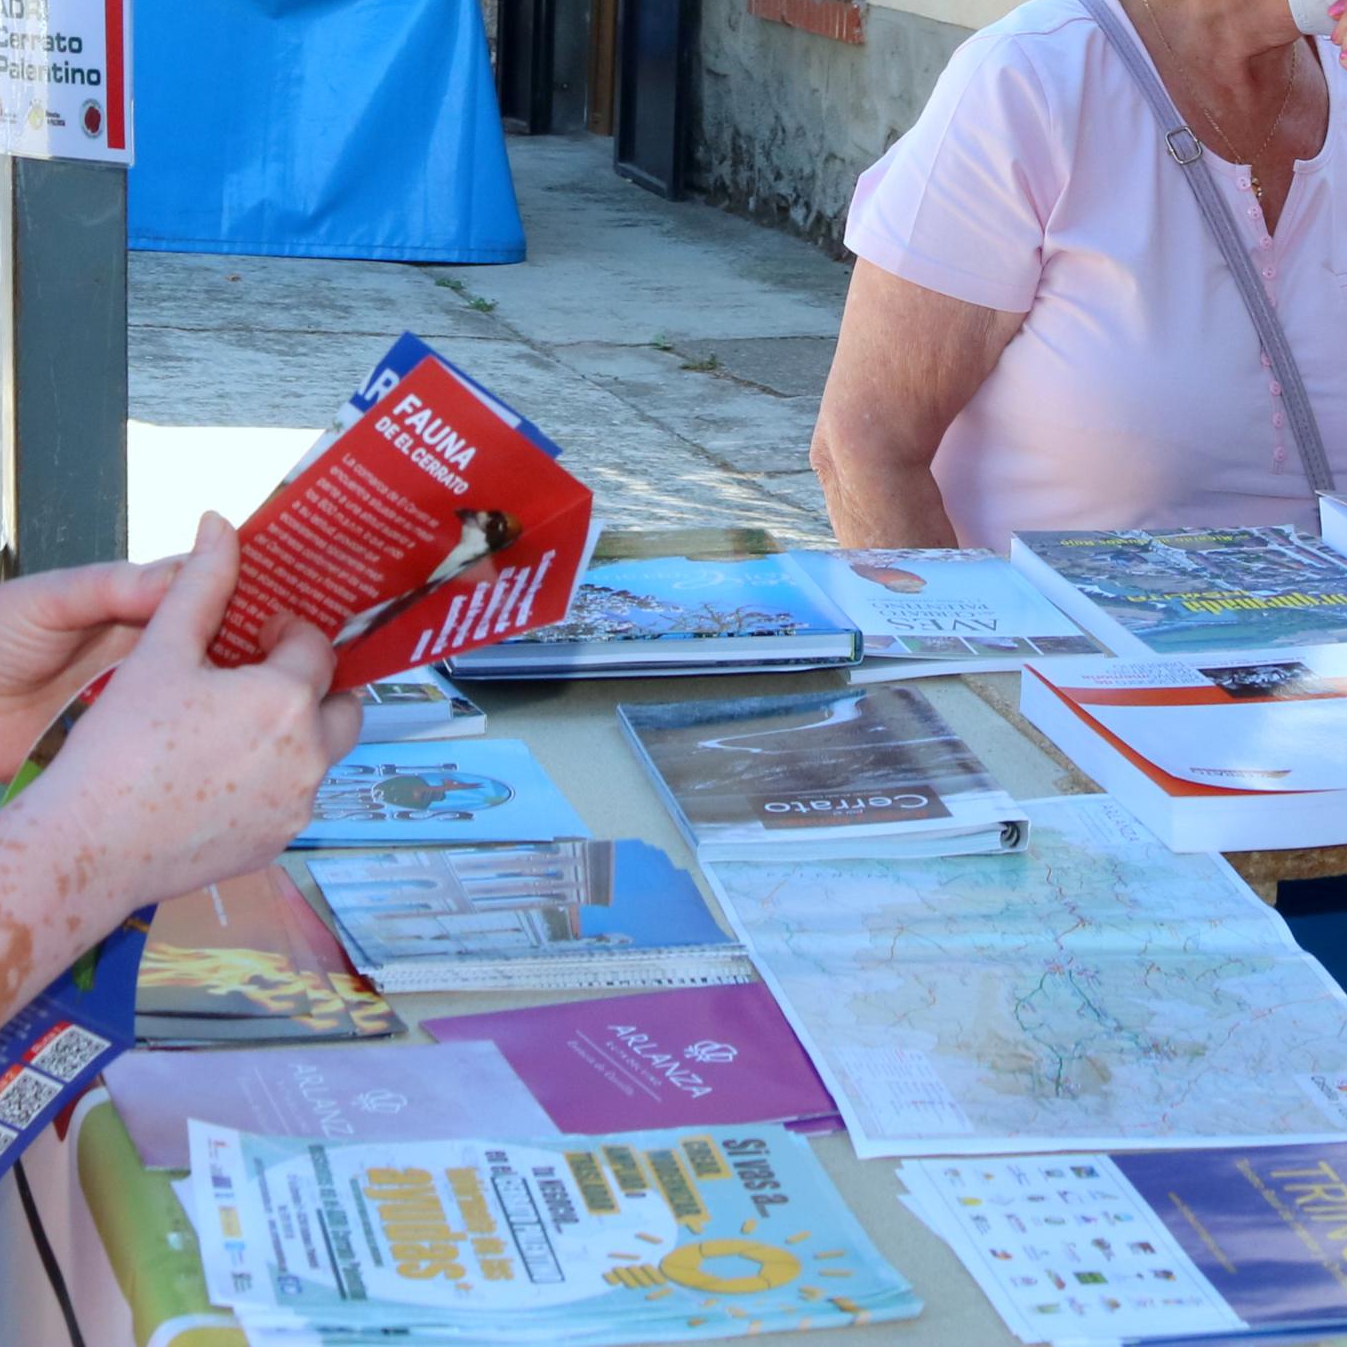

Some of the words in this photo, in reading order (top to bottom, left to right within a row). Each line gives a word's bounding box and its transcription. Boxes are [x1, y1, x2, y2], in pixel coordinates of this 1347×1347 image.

[393, 393, 477, 471] FAUNA
[374, 416, 400, 440] DE
[394, 432, 414, 455] EL
[410, 447, 469, 495] CERRATO
[879, 610, 975, 618] CERRATO
[886, 618, 999, 631] AVES
[763, 793, 929, 814] Cerrato
[607, 1025, 712, 1098] ARLANZA
[287, 1063, 356, 1139] ARLANZ
[722, 1138, 771, 1156] Si
[733, 1159, 781, 1190] vas
